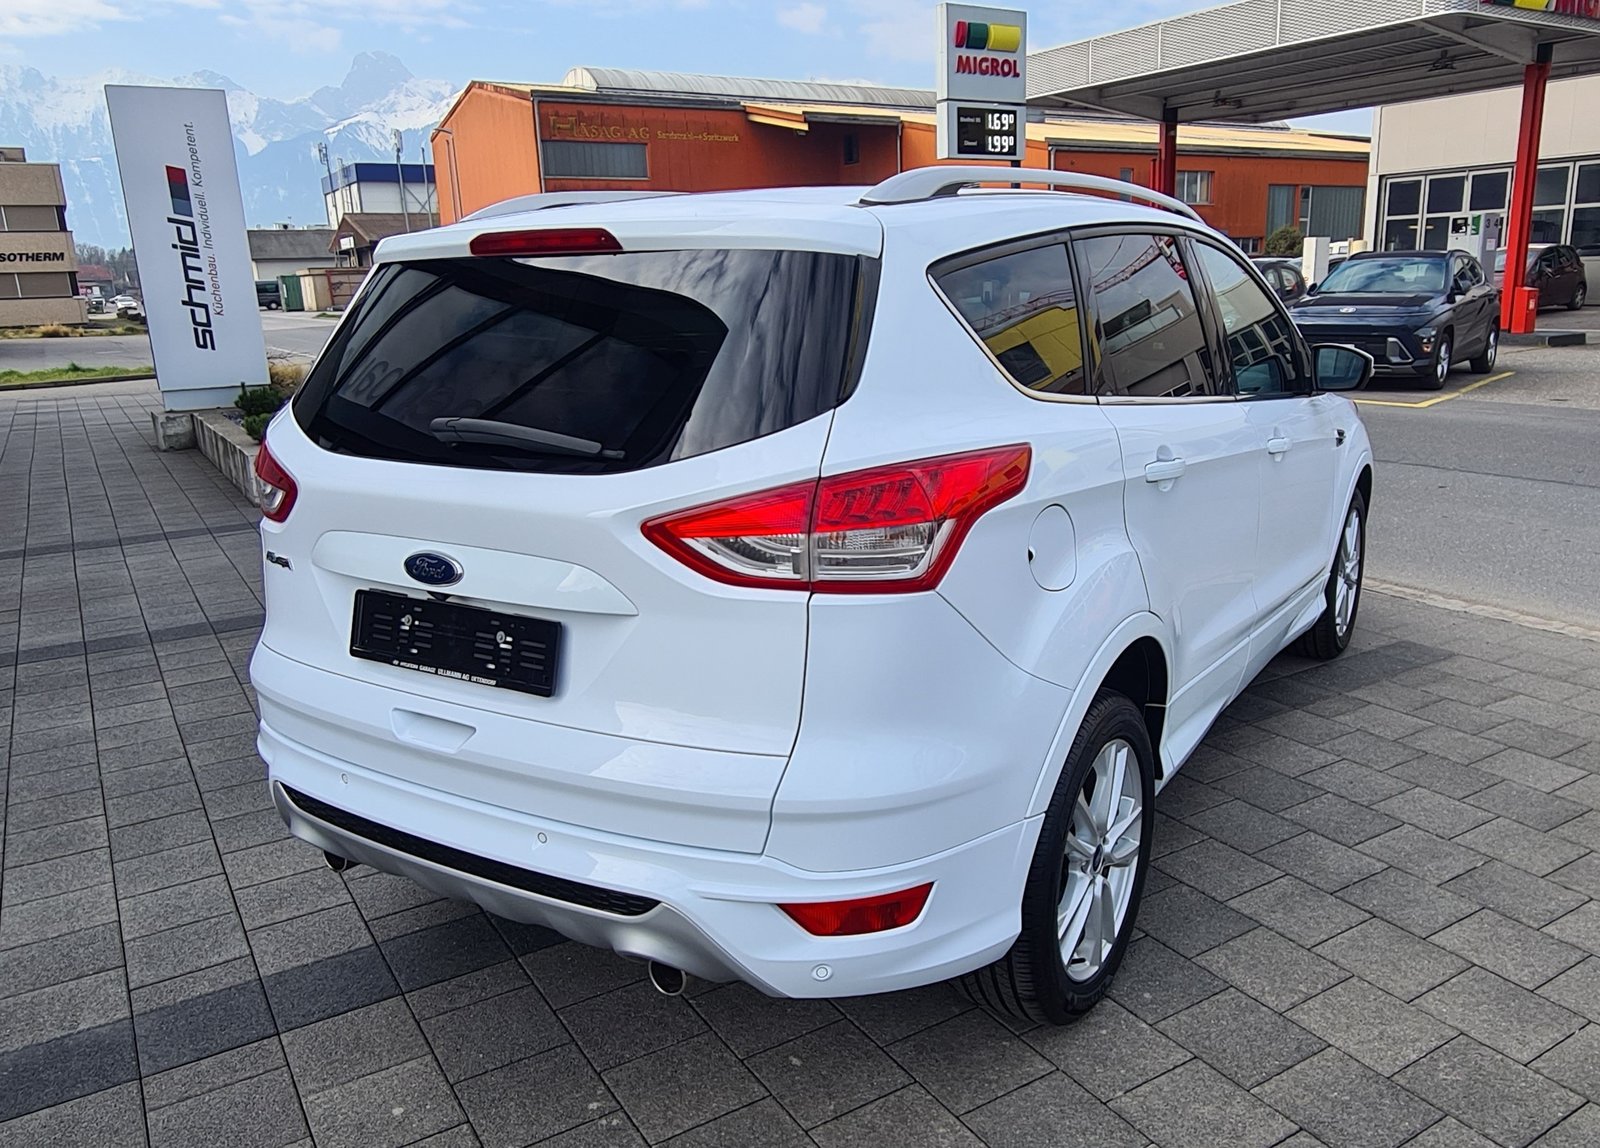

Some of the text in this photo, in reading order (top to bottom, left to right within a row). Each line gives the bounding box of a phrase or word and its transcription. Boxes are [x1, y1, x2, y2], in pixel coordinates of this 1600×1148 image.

[956, 55, 1020, 78] MIGROL
[628, 126, 650, 139] AG
[184, 121, 224, 316] Küchenbau. Individuell. Kompetent.
[1486, 219, 1491, 228] 3
[167, 217, 216, 350] schmid
[413, 557, 445, 578] Ford
[462, 673, 470, 681] AG
